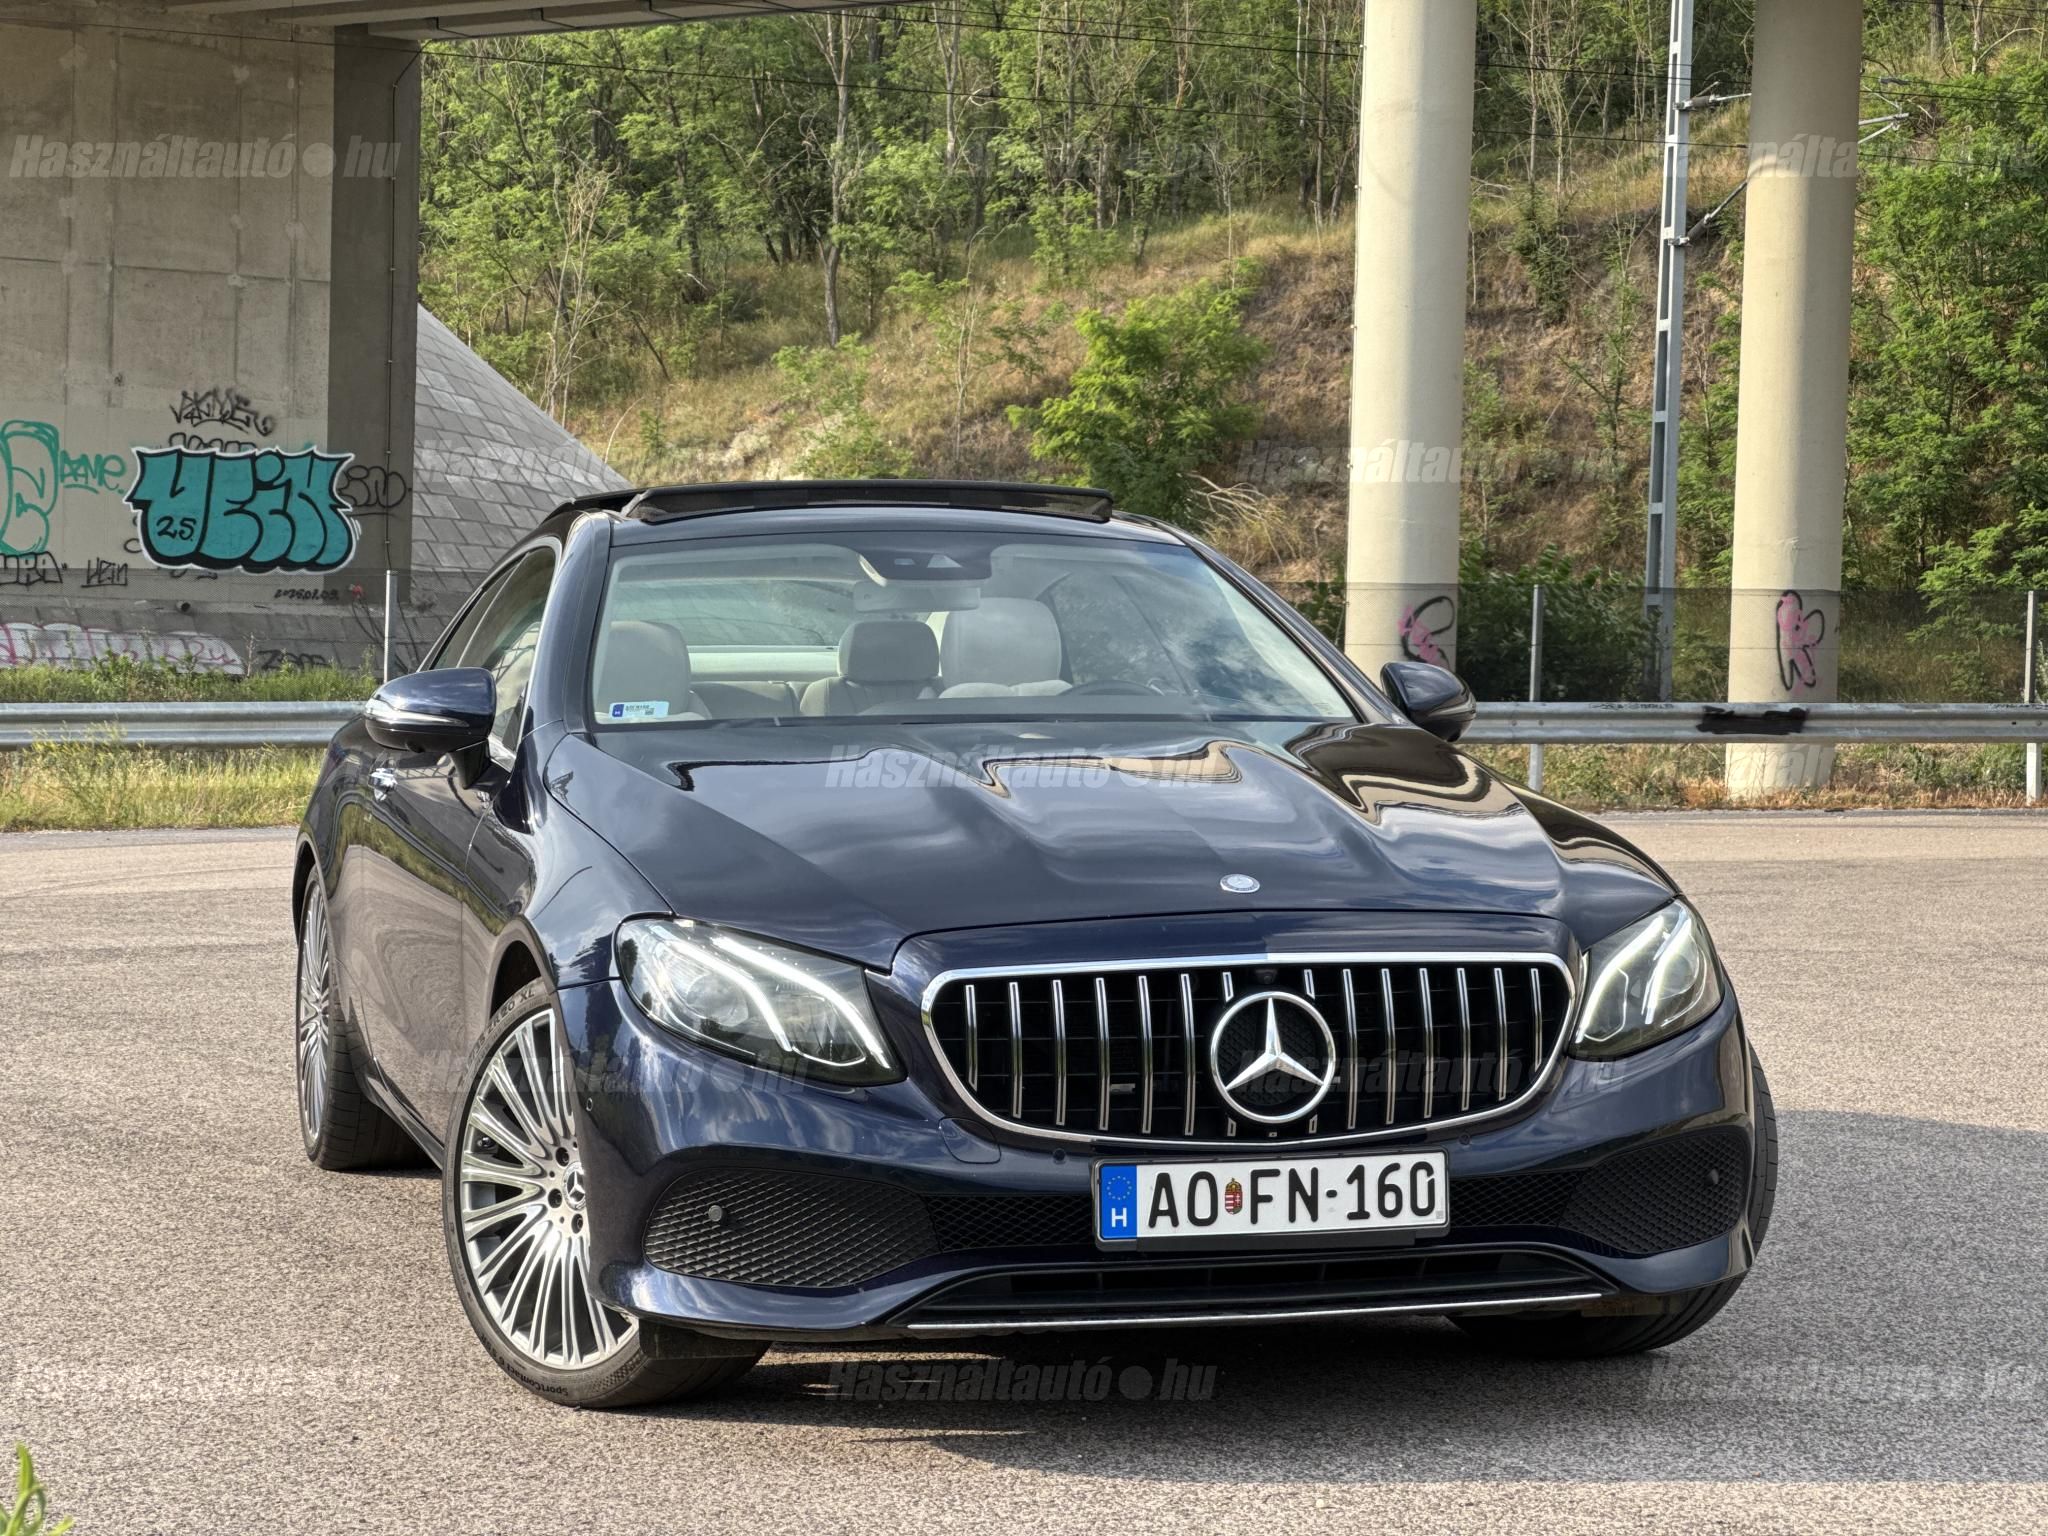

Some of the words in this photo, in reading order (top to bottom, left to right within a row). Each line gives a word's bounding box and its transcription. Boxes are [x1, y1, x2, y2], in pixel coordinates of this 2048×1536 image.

[1148, 1170, 1219, 1229] AO
[1249, 1160, 1437, 1225] FN-160
[1111, 1206, 1128, 1228] H
[505, 1362, 569, 1397] SportContact
